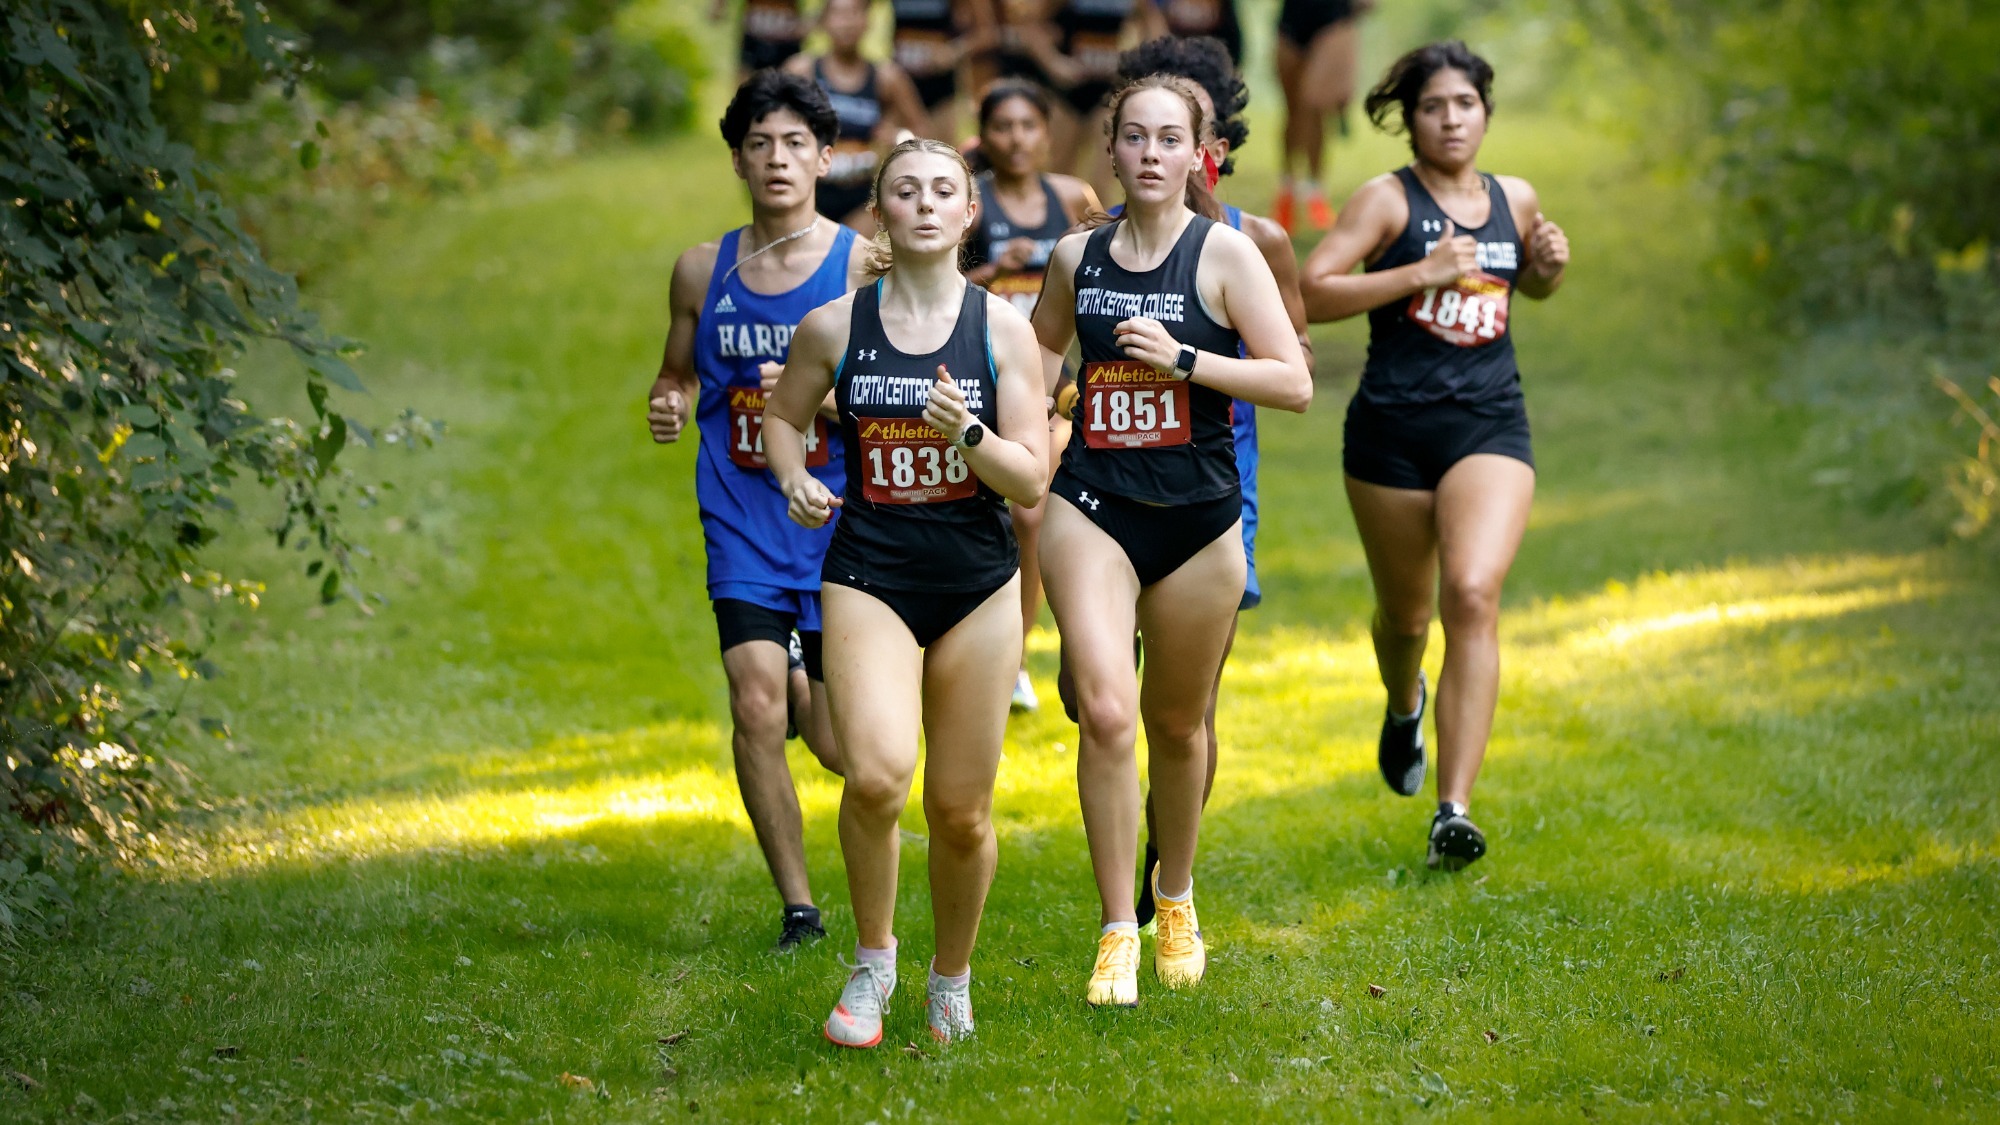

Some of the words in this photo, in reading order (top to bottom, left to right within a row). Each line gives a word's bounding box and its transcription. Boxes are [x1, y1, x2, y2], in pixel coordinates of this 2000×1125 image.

[1100, 289, 1144, 318] CENTRAL
[1143, 293, 1184, 322] COLLEGE
[1415, 285, 1497, 339] 1841
[849, 375, 886, 405] NORTH
[1089, 389, 1181, 432] 1851
[1137, 432, 1160, 440] PACK
[868, 446, 969, 488] 1838
[922, 488, 947, 496] PACK
